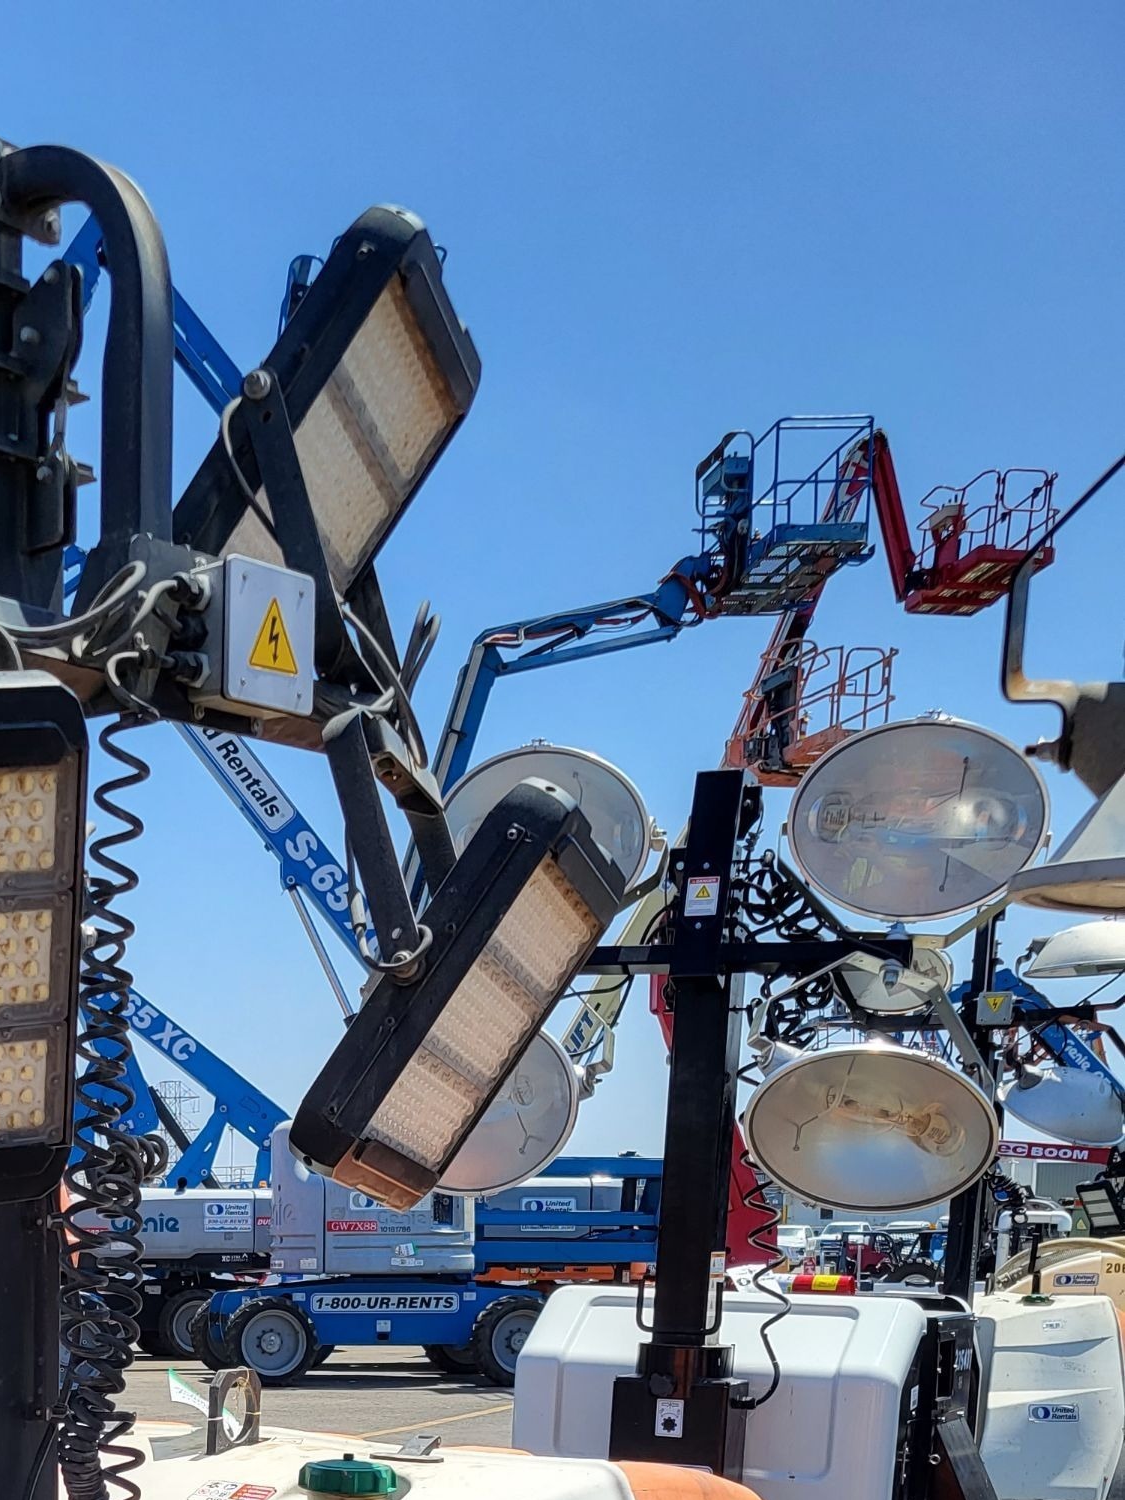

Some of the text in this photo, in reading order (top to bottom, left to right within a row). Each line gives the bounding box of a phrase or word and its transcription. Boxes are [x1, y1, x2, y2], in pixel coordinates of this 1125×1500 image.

[215, 739, 280, 819] Rentals
[285, 830, 349, 912] S-65
[150, 1020, 197, 1060] XC
[1030, 1146, 1089, 1160] BOOM
[331, 1221, 377, 1232] GW7X88
[315, 1296, 455, 1310] 1-800-UR-RENTS
